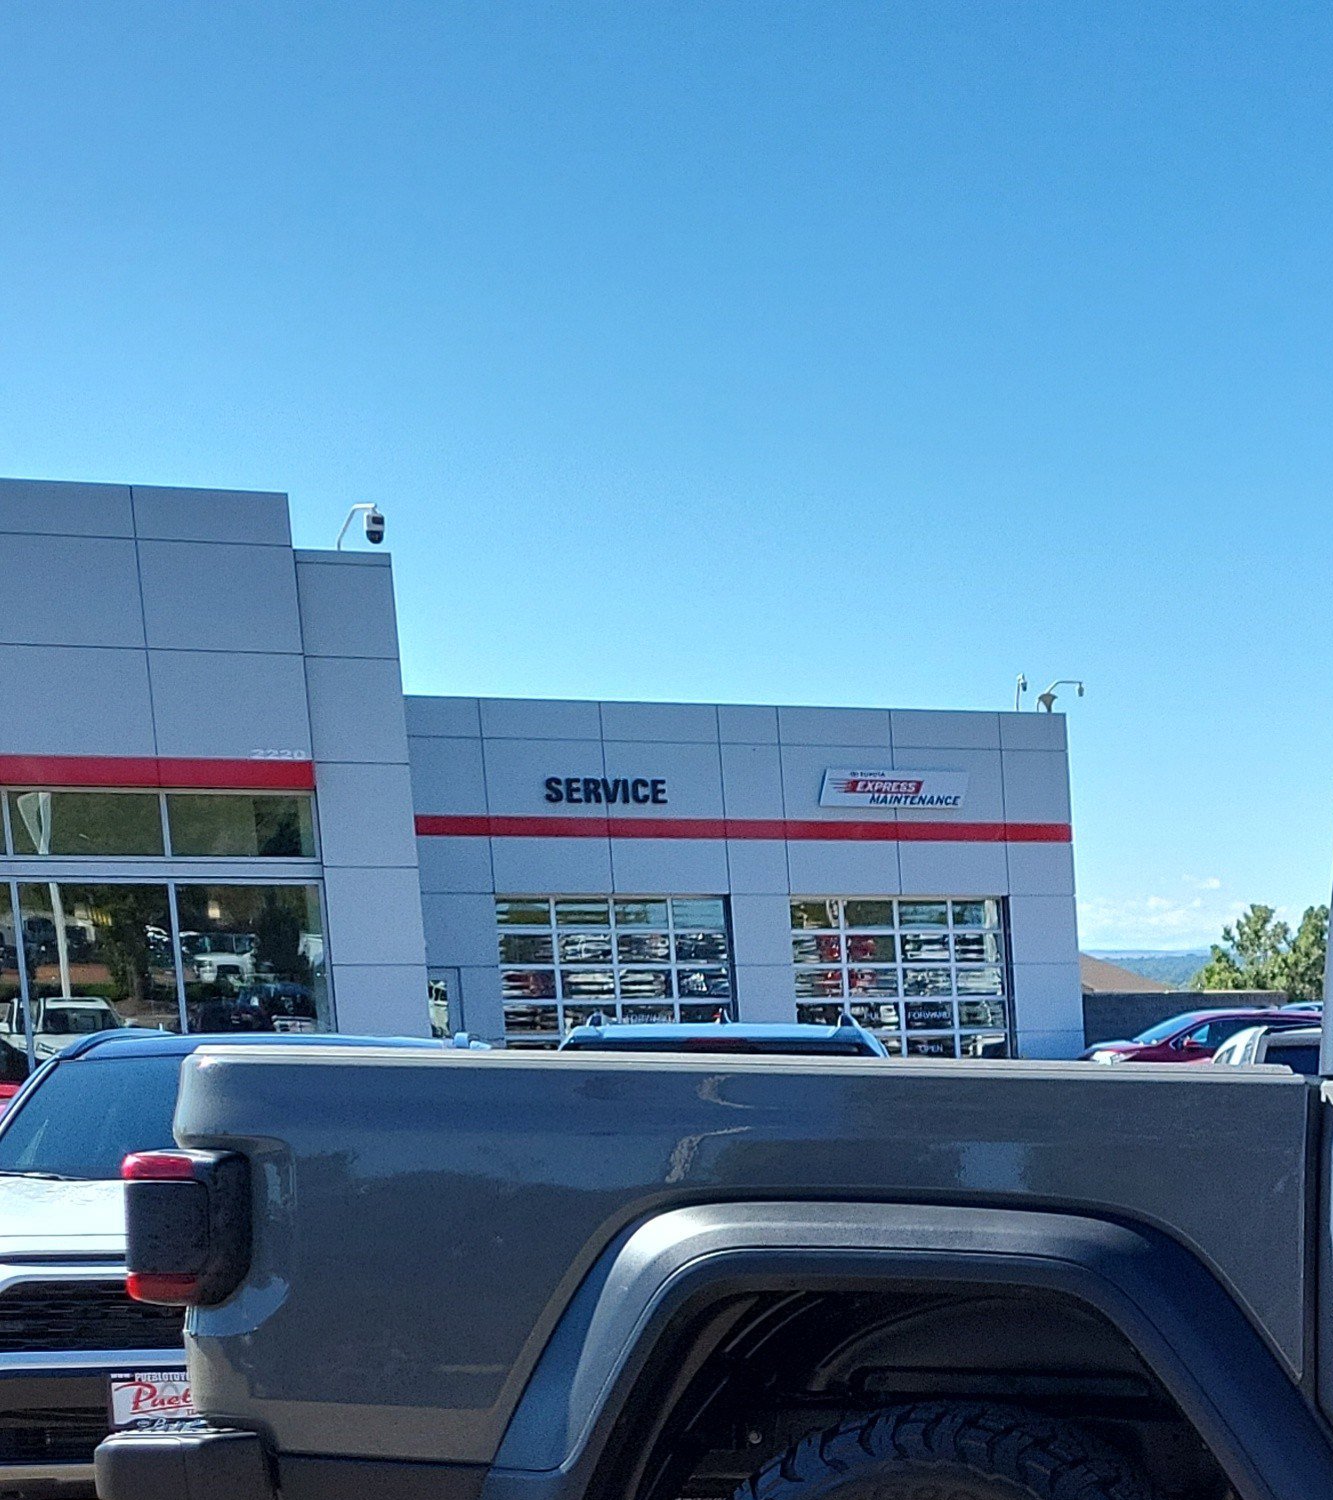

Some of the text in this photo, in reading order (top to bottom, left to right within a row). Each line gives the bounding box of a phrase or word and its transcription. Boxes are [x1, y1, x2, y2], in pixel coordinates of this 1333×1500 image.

[544, 776, 668, 804] SERVICE
[856, 781, 916, 793] EXPRESS
[868, 794, 961, 806] MAINTENANCE
